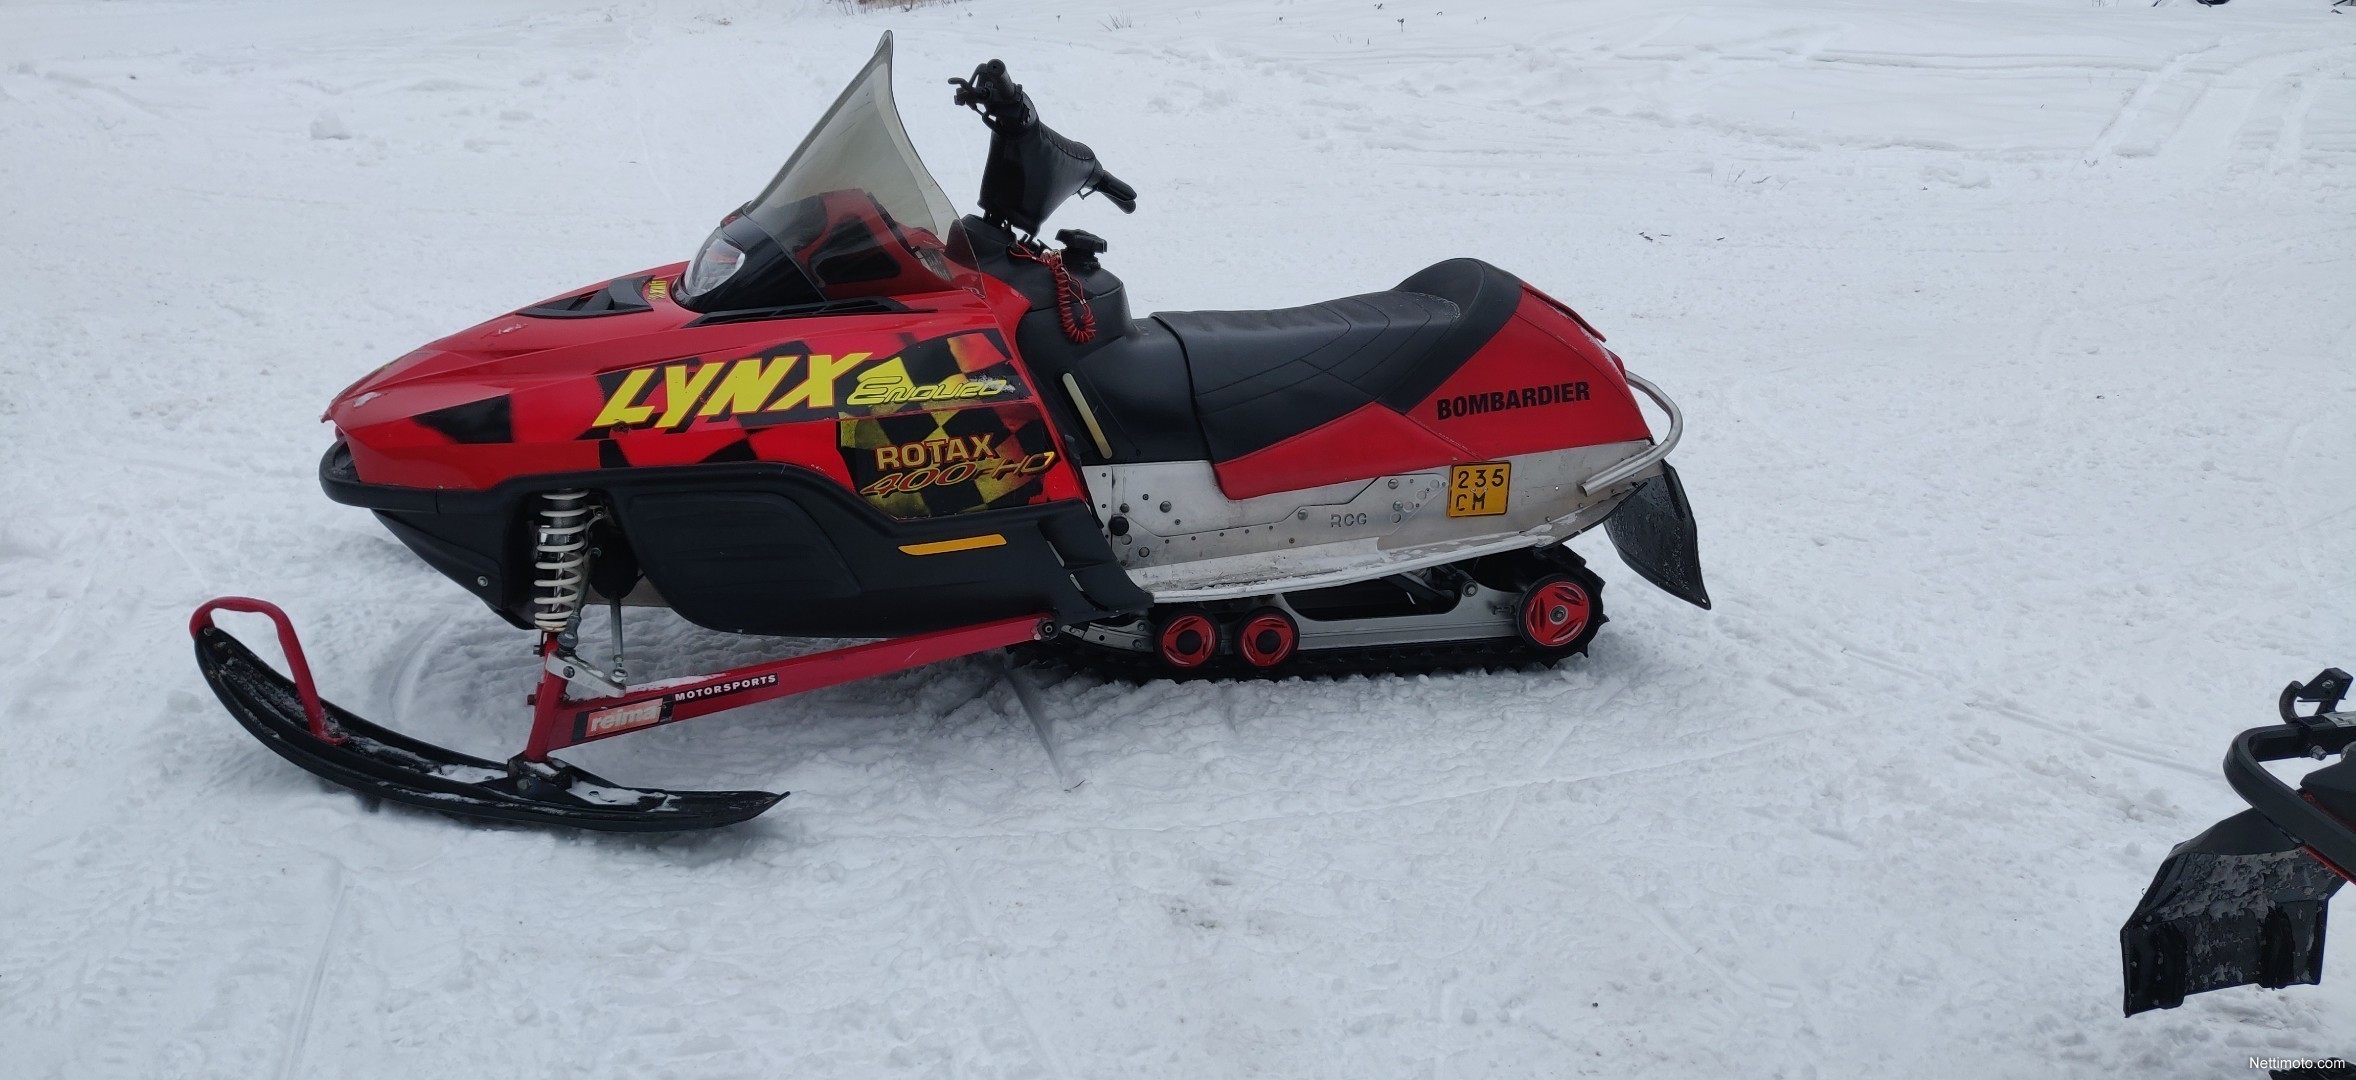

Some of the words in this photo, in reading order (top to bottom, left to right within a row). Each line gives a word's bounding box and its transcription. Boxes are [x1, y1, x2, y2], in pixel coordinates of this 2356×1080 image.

[591, 351, 874, 429] LYNX
[1437, 381, 1591, 420] BOMBARDIER
[876, 433, 1000, 471] ROTAX
[1457, 468, 1505, 489] 235
[1456, 491, 1486, 511] CM
[674, 674, 777, 702] MOTORSPORTS
[590, 705, 660, 732] reima
